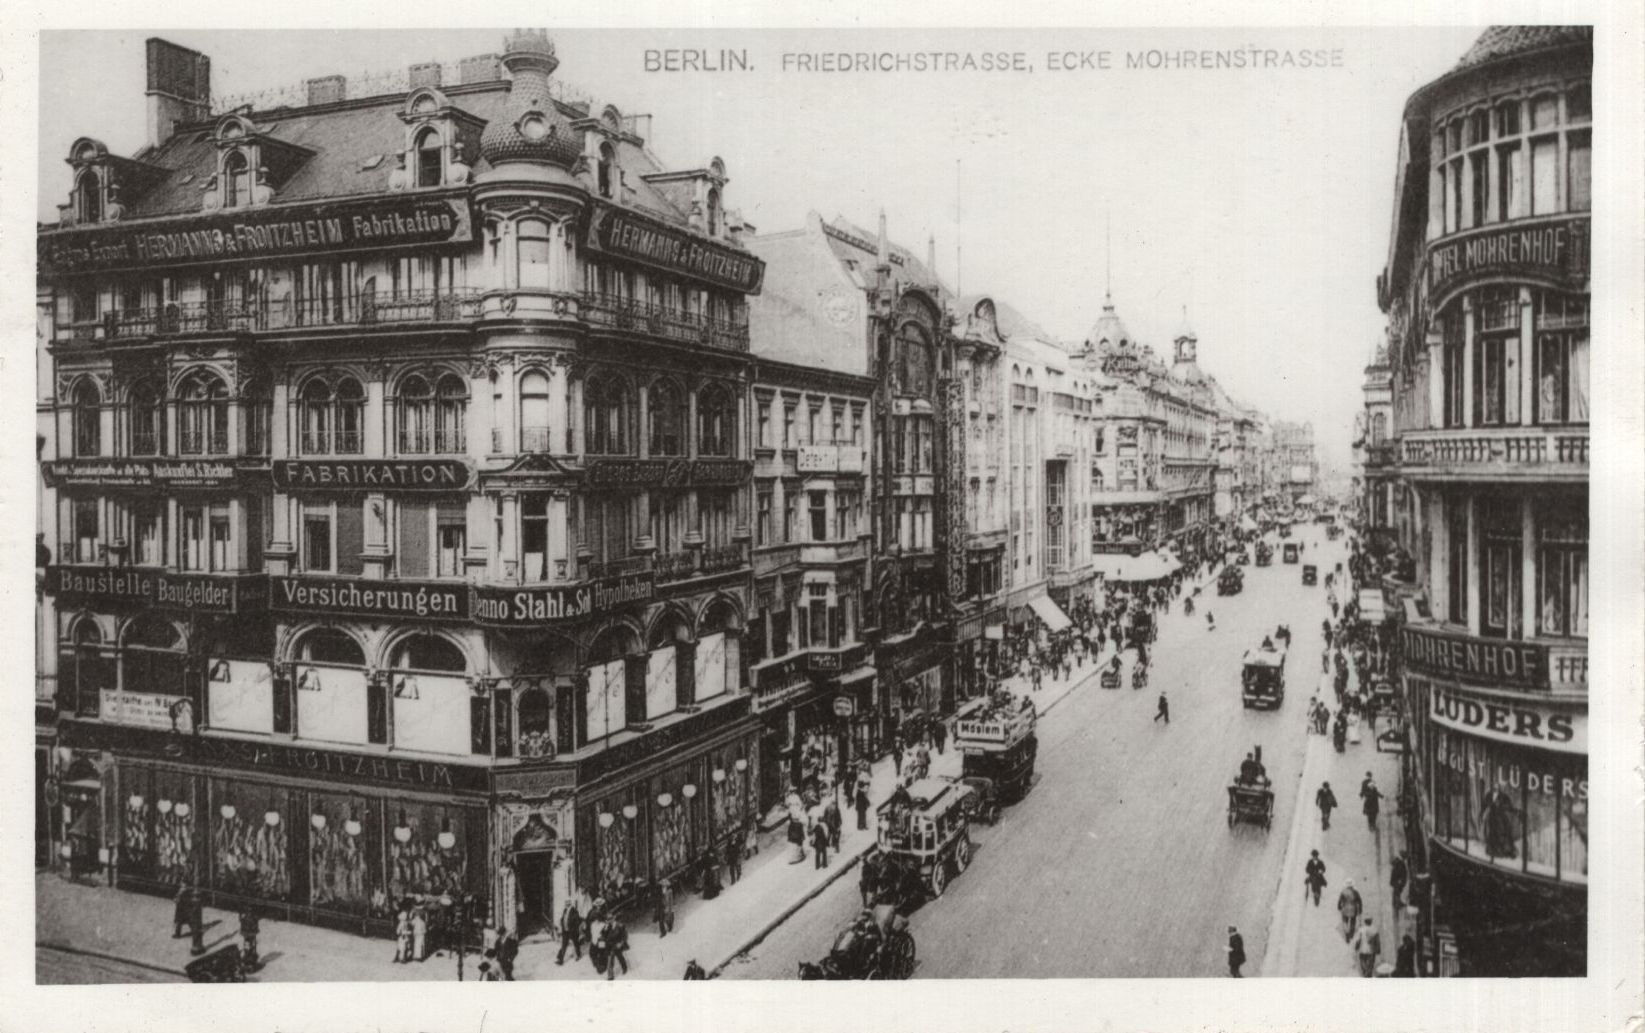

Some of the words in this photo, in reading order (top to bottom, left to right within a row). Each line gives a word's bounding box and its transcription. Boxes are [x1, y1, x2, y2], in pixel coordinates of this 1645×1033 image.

[234, 218, 343, 249] FROITZHEIM
[352, 210, 451, 239] Fabrikation
[610, 217, 681, 265] HERMANNS
[688, 243, 752, 283] FROITZHEIM
[1465, 227, 1566, 270] MOHRENHOF
[286, 462, 456, 483] FABRIKATION
[158, 578, 229, 607] Baugelder
[282, 580, 457, 616] Versicherungen
[514, 592, 565, 620] Stahl
[566, 604, 575, 617] &
[1402, 631, 1536, 676] MOHRENHOF
[1499, 764, 1588, 799] LÜDERS
